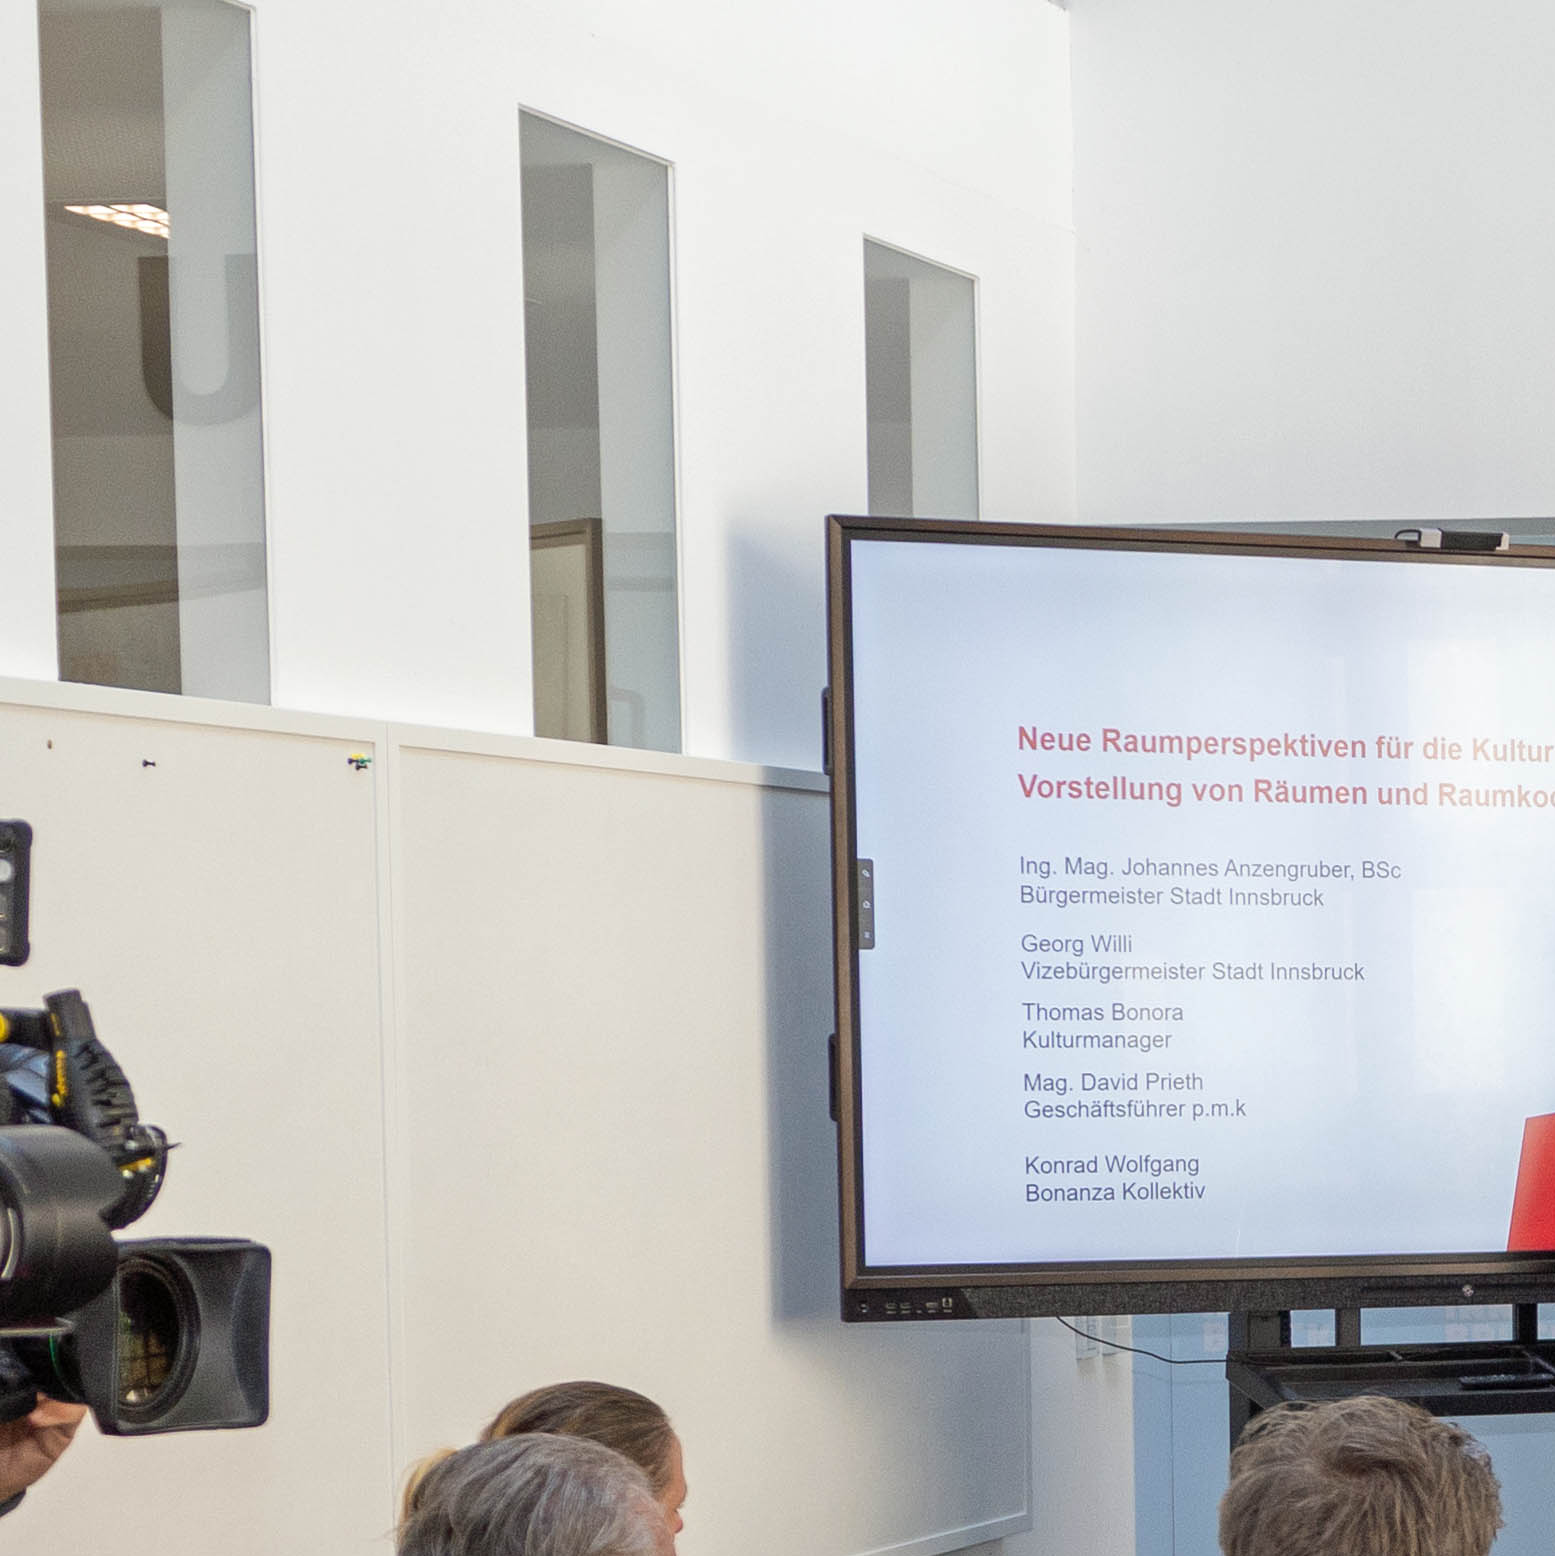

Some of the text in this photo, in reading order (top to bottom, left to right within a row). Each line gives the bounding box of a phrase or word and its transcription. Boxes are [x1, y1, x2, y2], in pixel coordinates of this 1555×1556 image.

[1018, 726, 1091, 752] Neue
[1102, 728, 1366, 761] Raumperspektiven
[1375, 735, 1414, 760] für
[1422, 736, 1462, 761] die
[1472, 737, 1554, 762] Kultur
[1018, 774, 1182, 807] Vorstellung
[1192, 783, 1243, 802] von
[1254, 779, 1367, 805] Räumen
[1377, 783, 1428, 806] und
[1020, 856, 1401, 882] Ing. Mag. Johannes Anzengruber, BSc
[1020, 886, 1324, 908] Bürgermeister Stadt Innsbruck
[1021, 935, 1132, 957] Georg Willi
[1021, 961, 1365, 984] Vizebürgermeister Stadt Innsbruck
[1022, 1003, 1184, 1021] Thomas Bonora
[1023, 1031, 1172, 1053] Kulturmanager
[1024, 1072, 1203, 1095] Mag. David Prieth
[1024, 1099, 1247, 1120] Geschäftsführer p.m.k
[1025, 1155, 1199, 1177] Konrad Wolfgang
[1026, 1182, 1206, 1202] Bonanza Kollektiv
